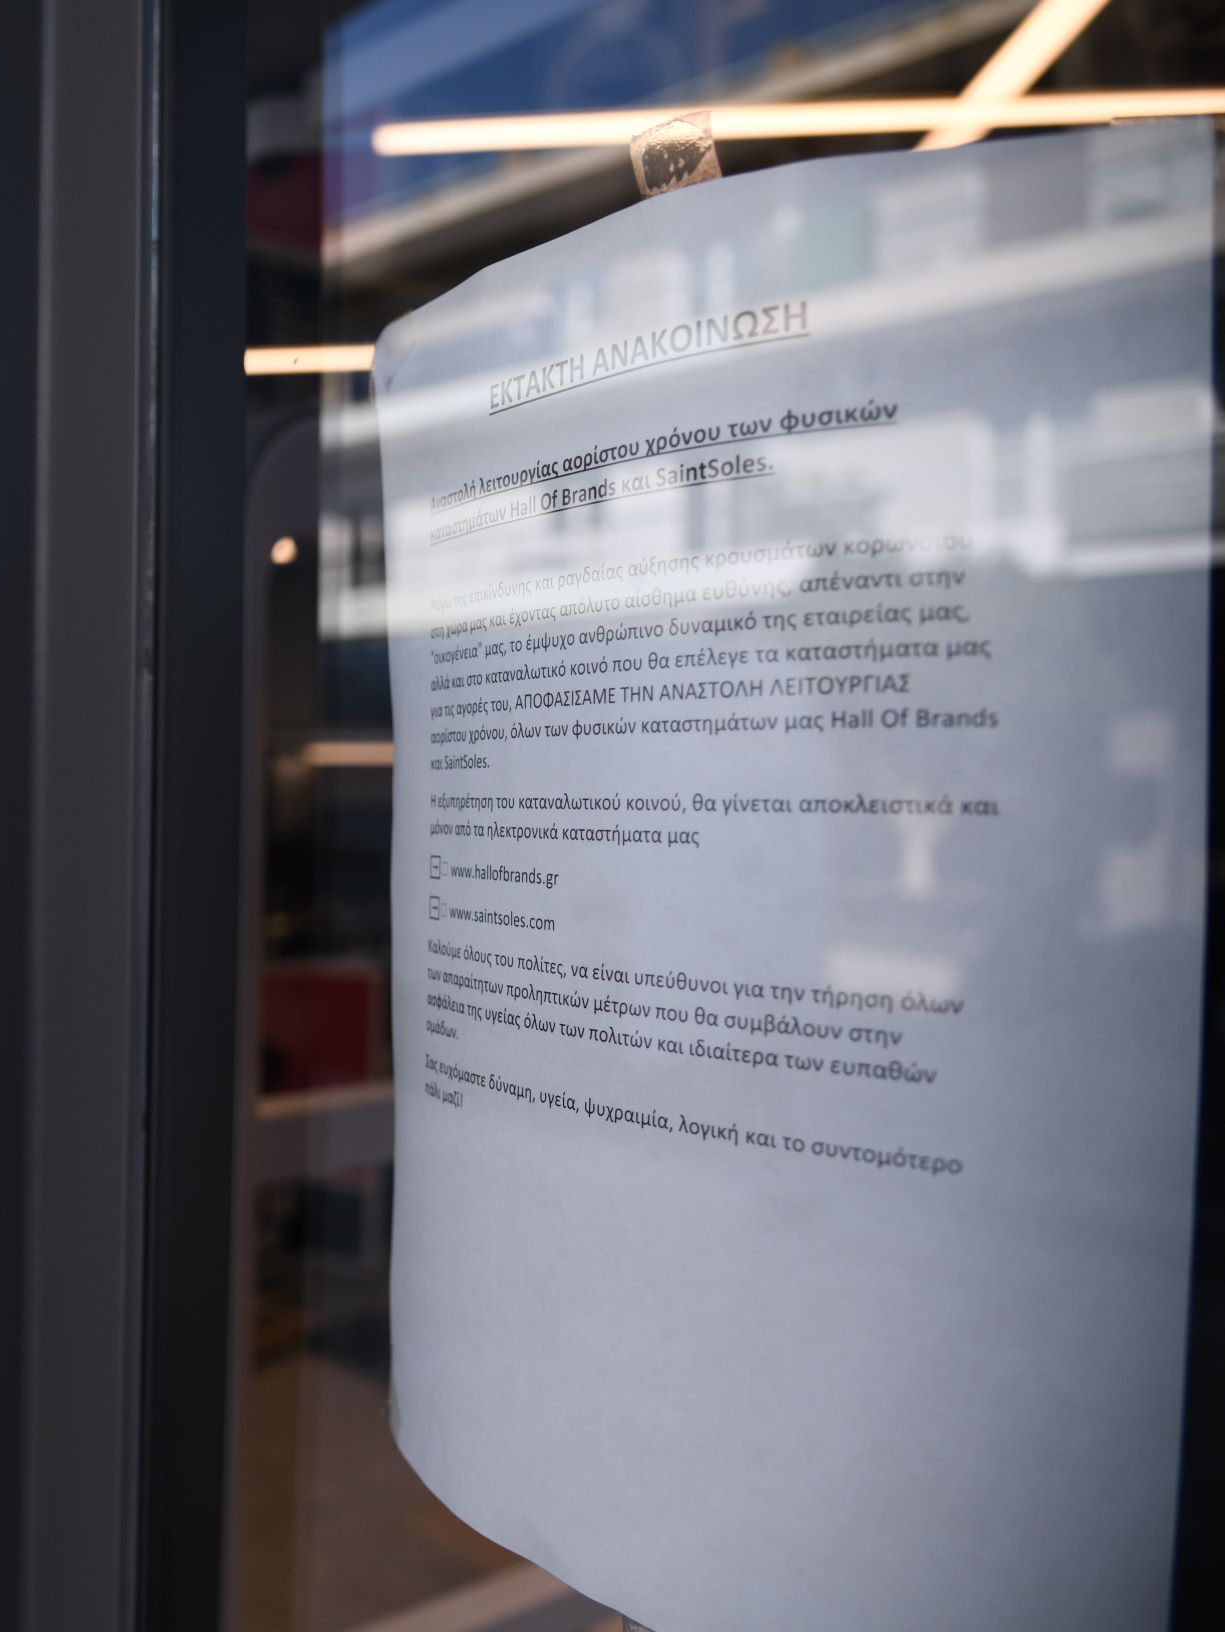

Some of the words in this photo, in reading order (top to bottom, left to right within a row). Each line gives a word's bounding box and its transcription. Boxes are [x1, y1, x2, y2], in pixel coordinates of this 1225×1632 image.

[489, 353, 585, 409] ΕΚΤΑΚΤΗ
[592, 300, 808, 376] ΑΝΑΚΟΙΝΩΣΗ
[430, 481, 476, 513] Αναστολή
[478, 460, 559, 496] λειτουργίας
[562, 437, 640, 475] αορίστου
[644, 423, 720, 457] χρόνου
[727, 416, 772, 438] των
[780, 397, 899, 434] φυσικών
[430, 503, 507, 542] καταστημάτων
[510, 489, 537, 517] Hall
[540, 489, 558, 512] Of
[561, 477, 616, 507] Brands
[621, 472, 652, 493] και
[655, 453, 774, 488] SaintSoles.
[468, 579, 532, 604] επικίνδυνης
[535, 578, 555, 592] και
[558, 562, 624, 591] ραγδαίας
[627, 555, 700, 577] αύξησης
[705, 538, 837, 570] κρουσμάτων
[430, 624, 445, 642] στη
[445, 618, 468, 640] χώρα
[469, 616, 487, 633] μας
[489, 613, 507, 628] και
[509, 605, 557, 628] έχοντας
[560, 595, 620, 617] απόλυτο
[624, 586, 697, 609] αίσθημα
[702, 577, 793, 600] ευθύνης,
[799, 570, 902, 593] απέναντι
[908, 569, 967, 590] στην
[430, 641, 483, 665] "οικογένεια"
[484, 641, 507, 660] μας,
[509, 639, 523, 653] το
[525, 632, 575, 651] έμψυχο
[579, 622, 664, 645] ανθρώπινο
[668, 610, 757, 637] δυναμικό
[762, 612, 797, 632] της
[803, 602, 913, 629] εταιρείας
[918, 604, 971, 626] μας,
[430, 674, 450, 692] αλλά
[451, 676, 465, 690] και
[466, 672, 483, 687] στο
[485, 660, 567, 687] καταναλωτικό
[570, 655, 608, 676] κοινό
[612, 656, 643, 673] που
[647, 651, 670, 669] θα
[675, 647, 749, 669] επέλεγε
[754, 648, 779, 664] τα
[785, 637, 939, 663] καταστήματα
[944, 639, 993, 662] μας
[430, 704, 443, 720] για
[444, 703, 455, 718] τις
[456, 696, 489, 718] αγορές
[491, 699, 512, 713] του,
[514, 687, 616, 710] ΑΠΟΦΑΣΙΣΑΜΕ
[620, 684, 654, 703] ΤΗΝ
[659, 679, 764, 701] ΑΝΑΣΤΟΛΗ
[769, 673, 912, 696] ΛΕΙΤΟΥΡΓΙΑΣ
[430, 726, 467, 746] αορίστου
[468, 724, 508, 744] χρόνου,
[510, 722, 542, 739] όλων
[544, 723, 569, 737] των
[572, 716, 637, 740] φυσικών
[641, 712, 779, 735] καταστημάτων
[784, 714, 825, 734] μας
[830, 708, 874, 729] Hall
[880, 707, 910, 729] Of
[915, 706, 1000, 729] Brands
[430, 756, 443, 770] και
[444, 753, 490, 771] SaintSoles.
[429, 819, 453, 838] μόνον
[454, 820, 472, 837] από
[474, 824, 485, 837] τα
[487, 821, 558, 842] ηλεκτρονικά
[562, 824, 663, 846] καταστήματα
[667, 829, 701, 848] μας
[430, 794, 437, 809] Η
[437, 792, 494, 812] εξυπηρέτηση
[496, 795, 515, 809] του
[518, 793, 621, 811] καταναλωτικού
[626, 793, 686, 814] κοινού,
[691, 793, 717, 813] θα
[722, 793, 793, 816] γίνεται
[798, 792, 954, 816] αποκλειστικά
[959, 798, 1000, 817] και
[450, 863, 560, 890] www.hallofbrands.gr
[449, 906, 556, 932] www.saintsoles.com
[427, 938, 462, 961] Καλούμε
[463, 944, 492, 967] όλους
[494, 953, 514, 967] του
[517, 955, 567, 979] πολίτες,
[571, 964, 589, 979] να
[592, 963, 630, 985] είναι
[634, 970, 729, 995] υπεύθυνοι
[733, 982, 765, 1000] για
[770, 984, 806, 1005] την
[811, 984, 894, 1014] τήρηση
[900, 990, 966, 1015] όλων
[426, 1017, 460, 1041] ομάδων.
[427, 966, 442, 981] των
[442, 969, 504, 995] απαραίτητων
[506, 983, 589, 1009] προληπτικών
[593, 994, 651, 1019] μέτρων
[655, 1005, 689, 1023] που
[694, 1006, 719, 1027] θα
[724, 1013, 843, 1040] συμβάλουν
[848, 1025, 904, 1049] στην
[426, 991, 465, 1015] ασφάλεια
[467, 1003, 483, 1022] της
[485, 1007, 521, 1029] υγείας
[524, 1011, 556, 1033] όλων
[559, 1022, 585, 1039] των
[589, 1026, 653, 1049] πολιτών
[657, 1038, 684, 1055] και
[689, 1039, 779, 1068] ιδιαίτερα
[784, 1053, 825, 1072] των
[829, 1059, 938, 1085] ευπαθών
[424, 1081, 441, 1099] πάλι
[441, 1091, 464, 1109] μαζί!
[424, 1053, 438, 1072] Σας
[439, 1060, 487, 1088] ευχόμαστε
[488, 1073, 536, 1103] δύναμη,
[539, 1090, 579, 1114] υγεία,
[584, 1097, 674, 1133] ψυχραιμία,
[678, 1114, 739, 1146] λογική
[745, 1129, 777, 1149] και
[782, 1135, 805, 1153] το
[811, 1140, 964, 1176] συντομότερο
